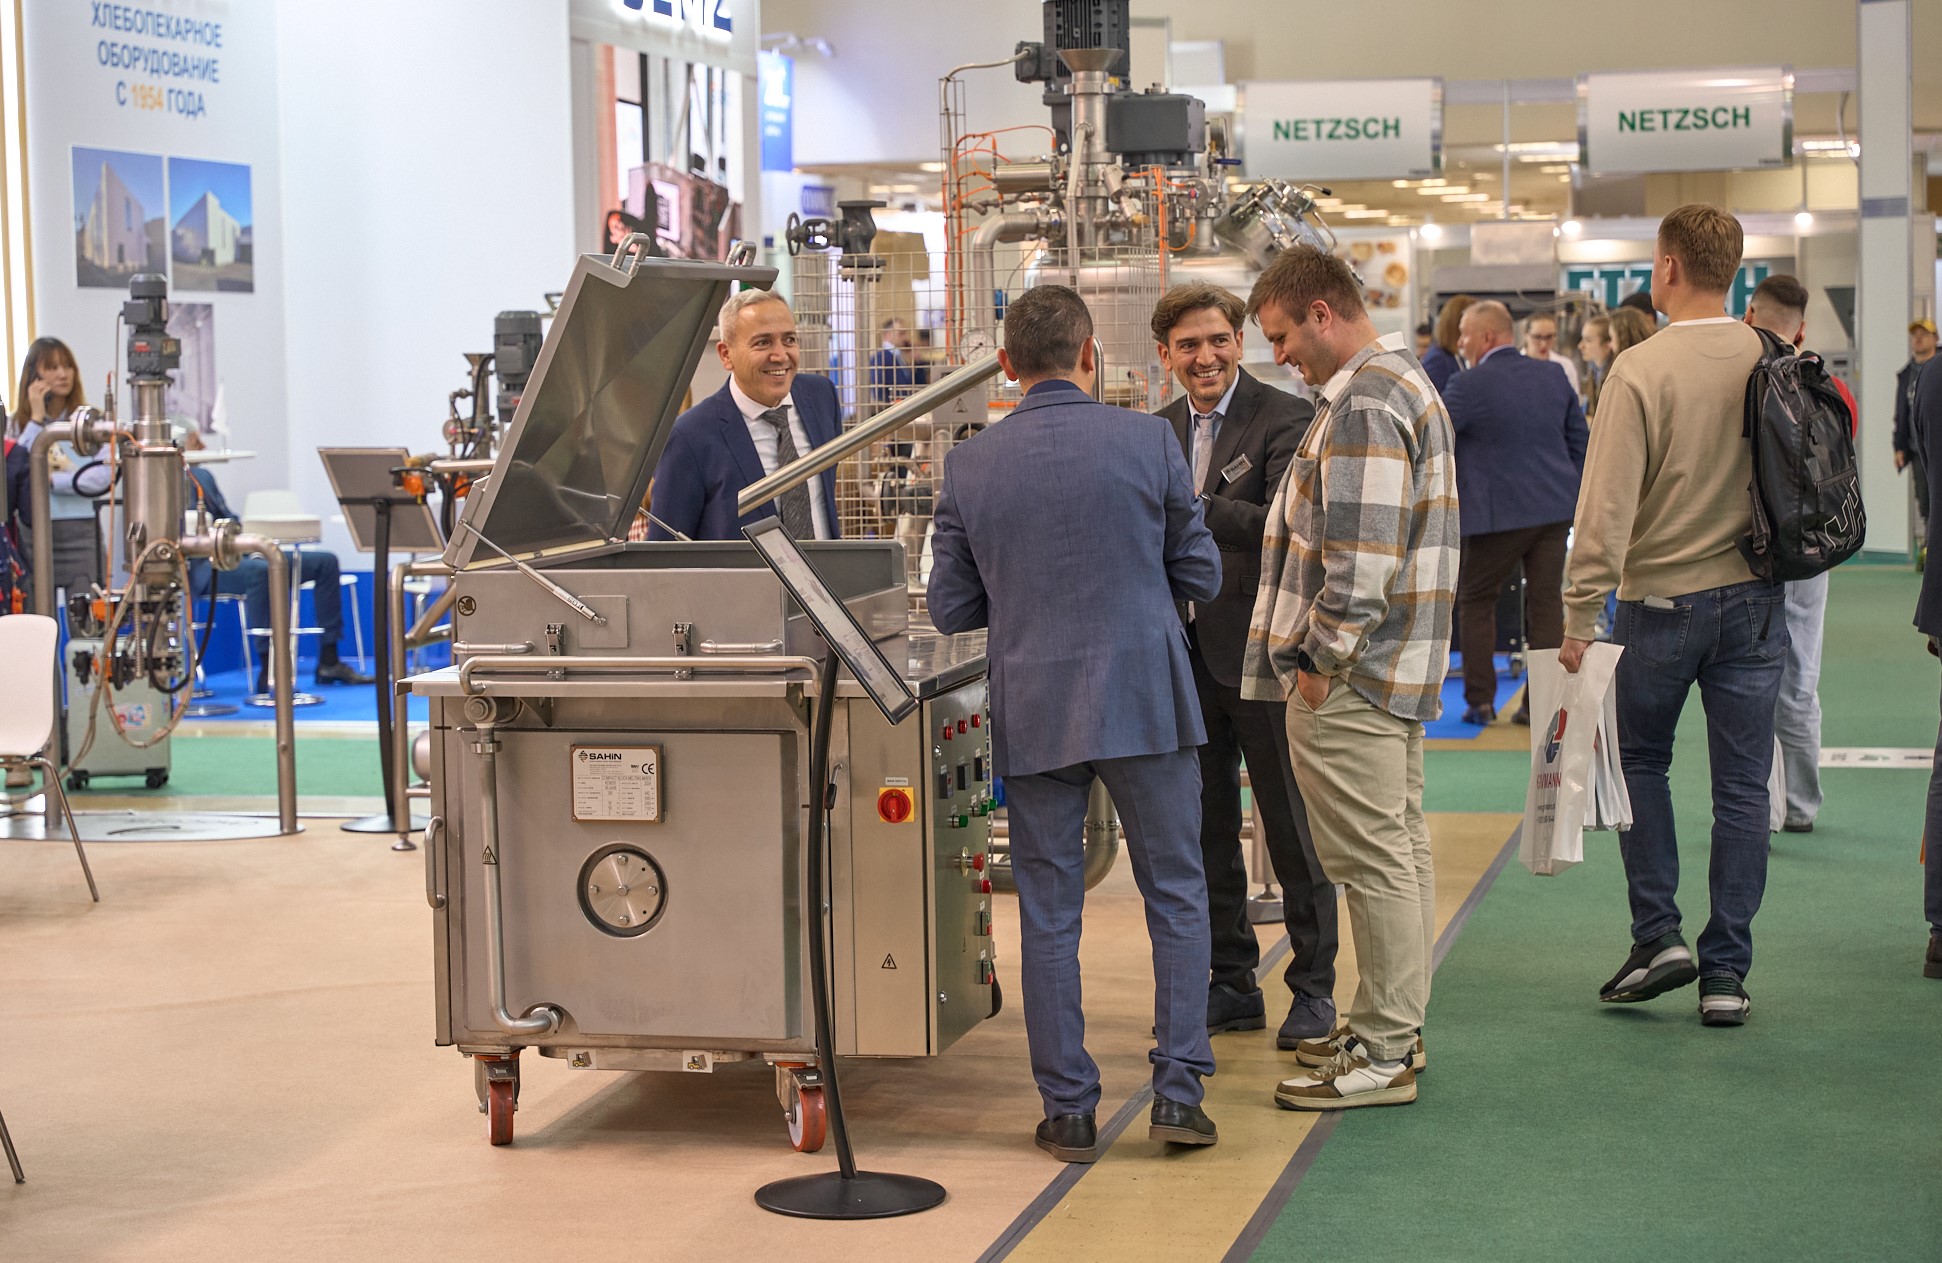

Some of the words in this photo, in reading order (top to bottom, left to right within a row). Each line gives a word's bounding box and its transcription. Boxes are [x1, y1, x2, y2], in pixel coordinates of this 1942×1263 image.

[91, 0, 223, 48] ХЛЕБОПЕКАРНОЕ
[97, 40, 220, 83] ОБОРУДОВАНИЕ
[116, 80, 127, 106] С
[131, 83, 164, 111] 1954
[167, 88, 206, 120] ГОДА
[1619, 105, 1750, 132] NETZSCH
[1273, 116, 1400, 141] NETZSCH
